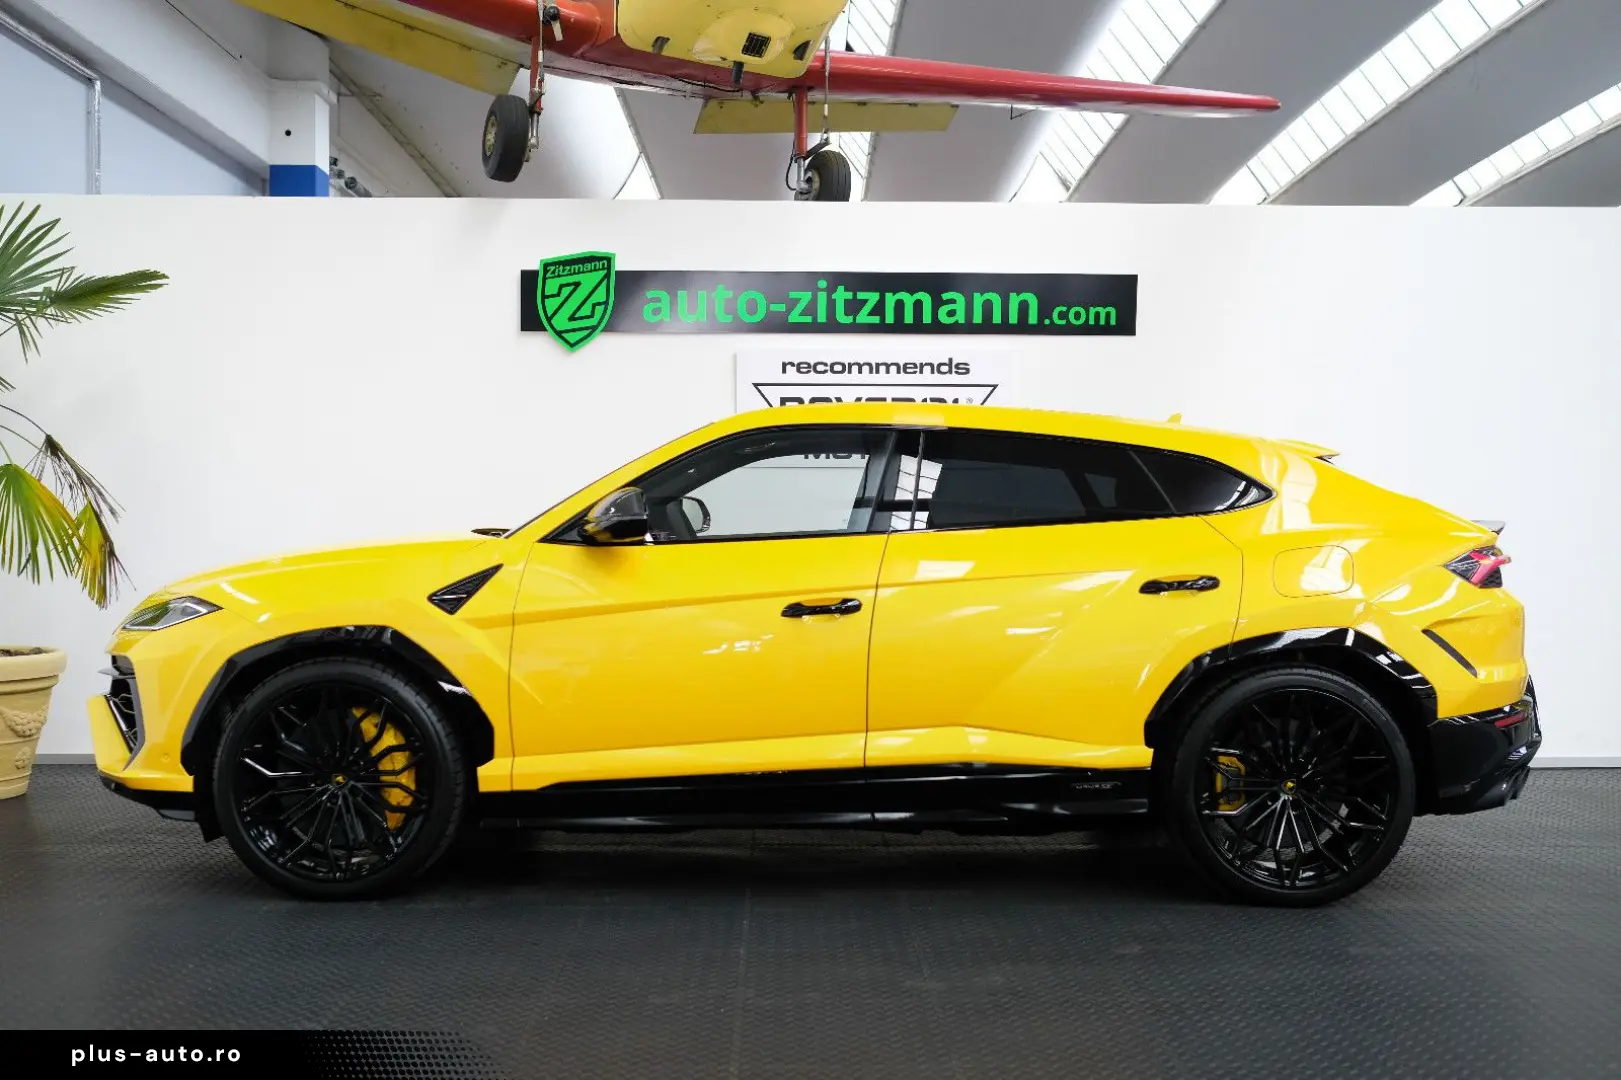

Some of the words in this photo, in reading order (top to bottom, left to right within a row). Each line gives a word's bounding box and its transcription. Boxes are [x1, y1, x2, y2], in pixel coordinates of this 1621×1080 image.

[546, 260, 608, 278] Zitzmann
[642, 278, 1117, 327] auto-zitzmann.com
[781, 357, 971, 376] recommends
